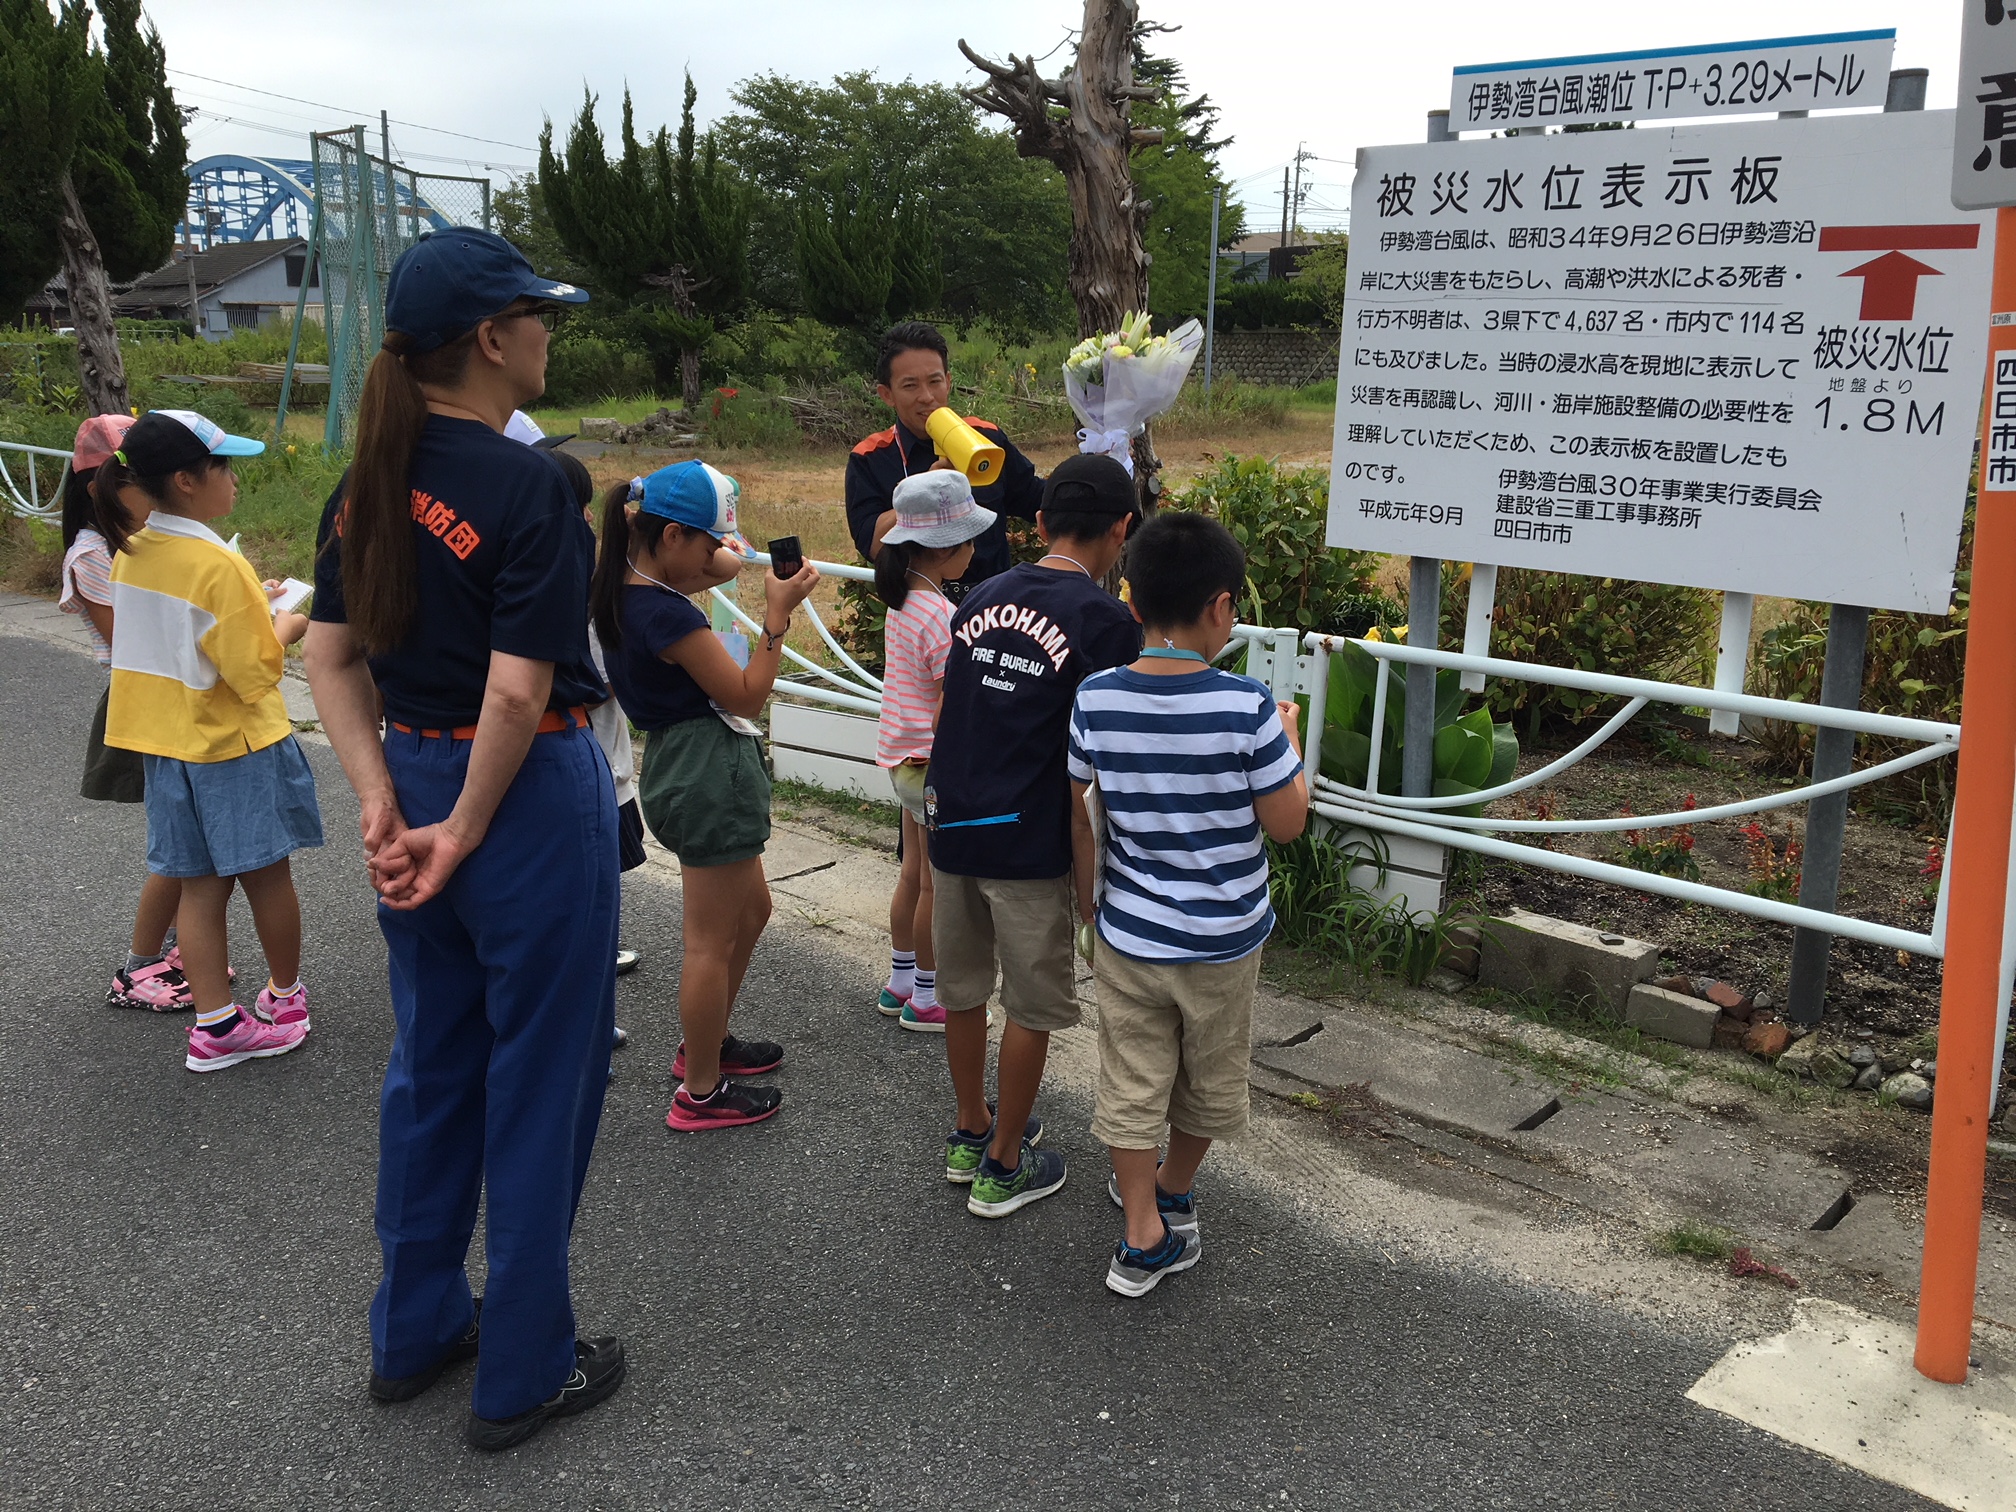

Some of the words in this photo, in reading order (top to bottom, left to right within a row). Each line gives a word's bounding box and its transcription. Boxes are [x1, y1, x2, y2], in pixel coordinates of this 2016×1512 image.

[1468, 70, 1636, 122] 伊勢湾台風潮位
[1377, 156, 1782, 217] 被災水位表示板
[1354, 347, 1800, 380] にも及びました。当時の浸水高を現地に表示して
[1813, 324, 1954, 373] 被災水位
[1827, 376, 1913, 395] 地盤より
[1815, 396, 1945, 436] 1.8M
[1347, 423, 1788, 468] 理解していただくため、この表示板を設置したも
[1345, 461, 1405, 484] のです。
[1498, 468, 1823, 512] 伊勢湾台風30年事業実行委員会
[1358, 498, 1463, 525] 平成元年9月
[1495, 493, 1702, 529] 建設省三重工事事務所
[1493, 518, 1573, 544] 四日市市
[955, 603, 1070, 672] YOKOHAMA
[971, 646, 996, 664] FIRE
[999, 652, 1045, 677] BUREAU
